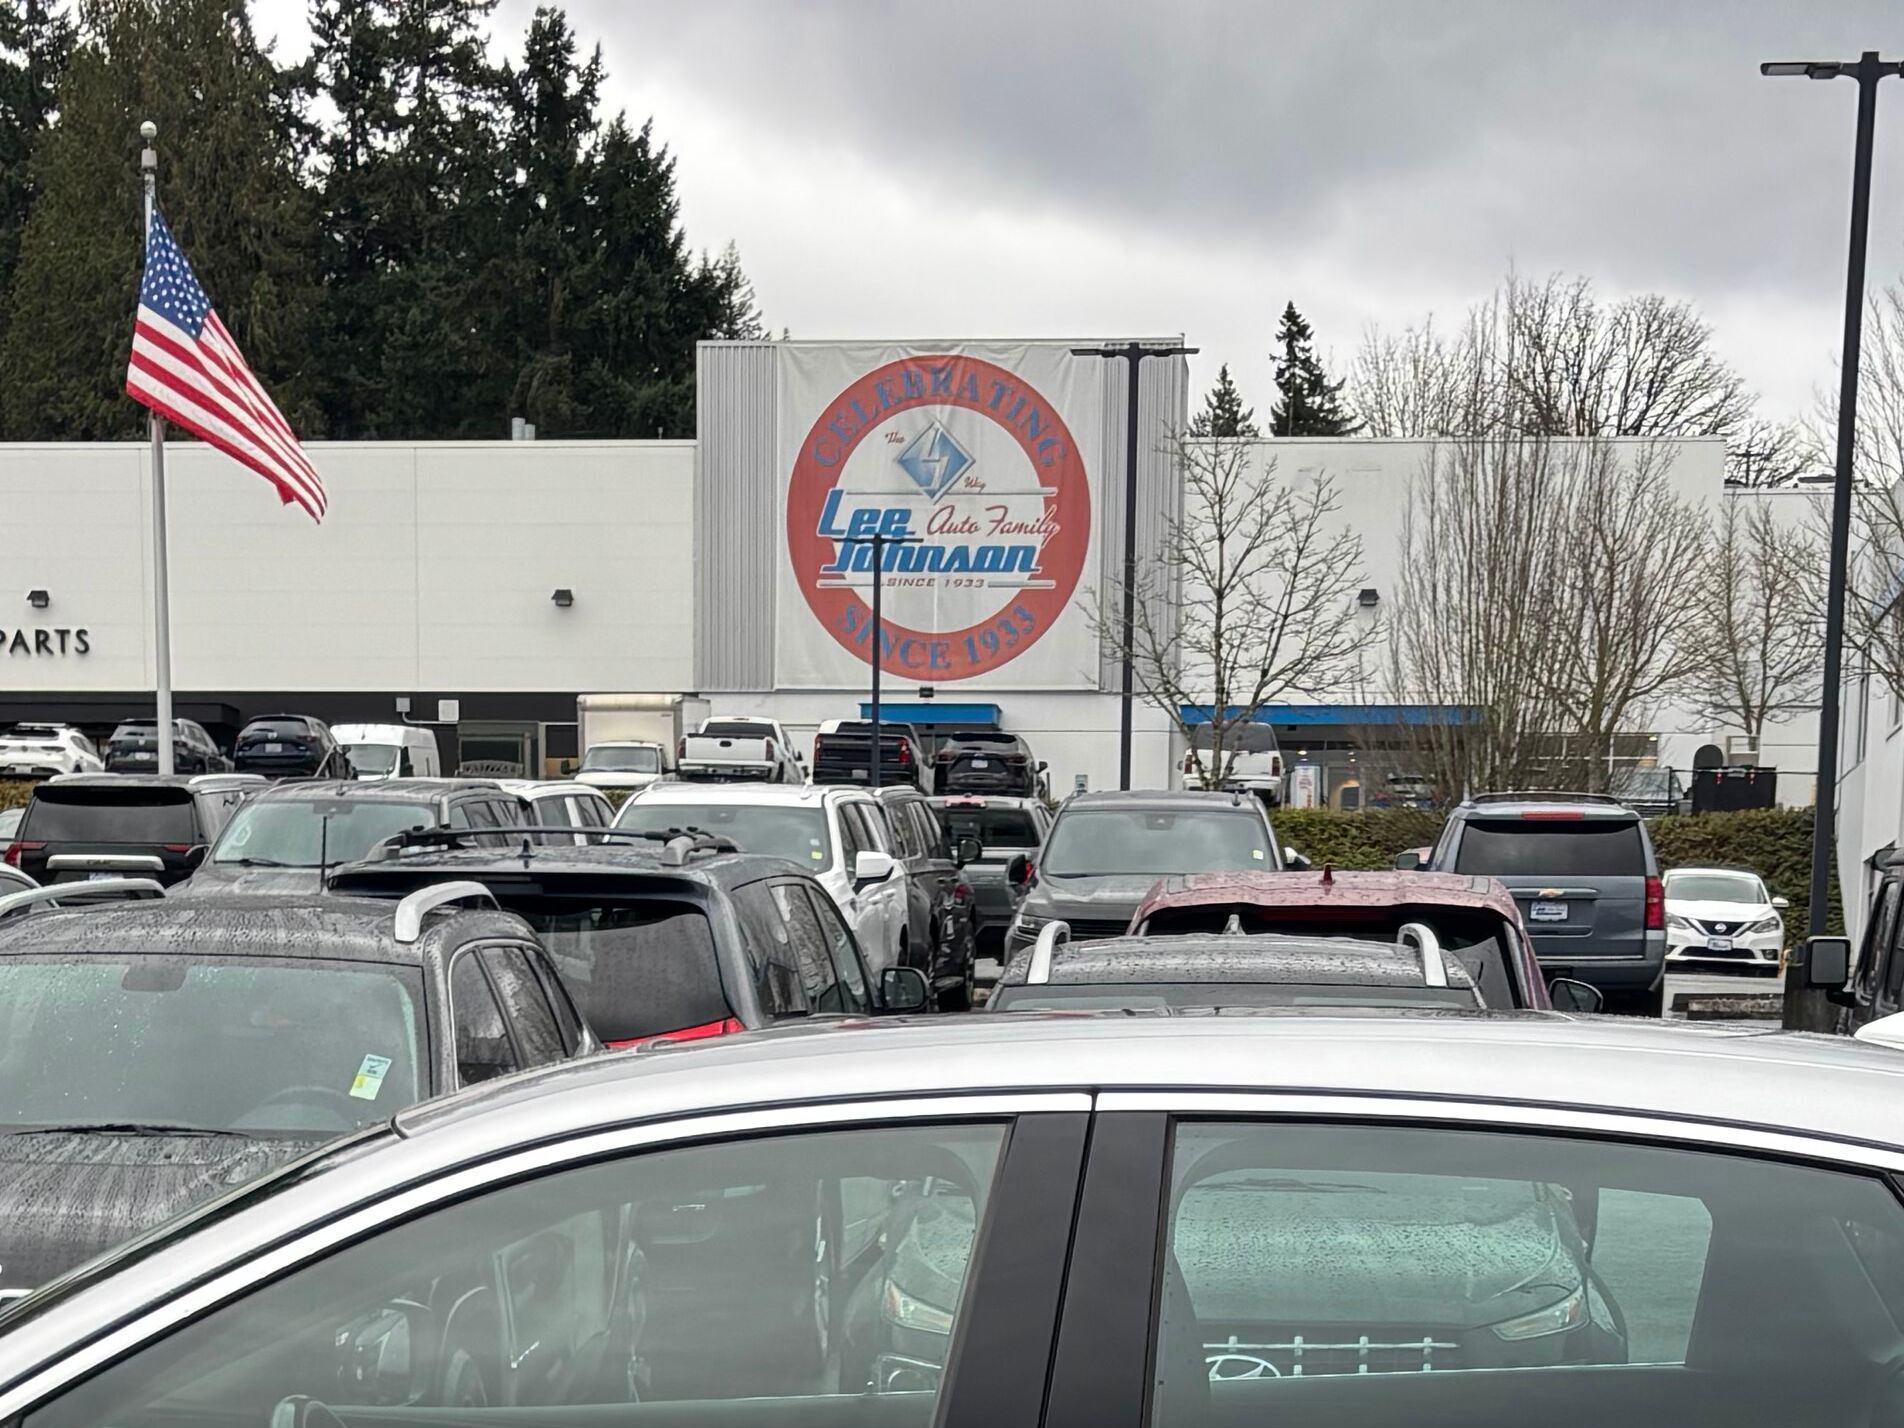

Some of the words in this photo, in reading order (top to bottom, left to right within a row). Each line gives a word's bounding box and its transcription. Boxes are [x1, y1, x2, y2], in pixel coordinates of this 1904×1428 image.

[812, 365, 1067, 468] CELEBRATING
[817, 488, 915, 537] Lee
[927, 505, 981, 535] Auto
[985, 505, 1060, 547] Family
[821, 537, 1042, 573] Johnson
[887, 578, 935, 588] SINCE
[944, 578, 985, 588] 1933
[836, 604, 951, 670] SINCE
[963, 603, 1036, 666] 1933
